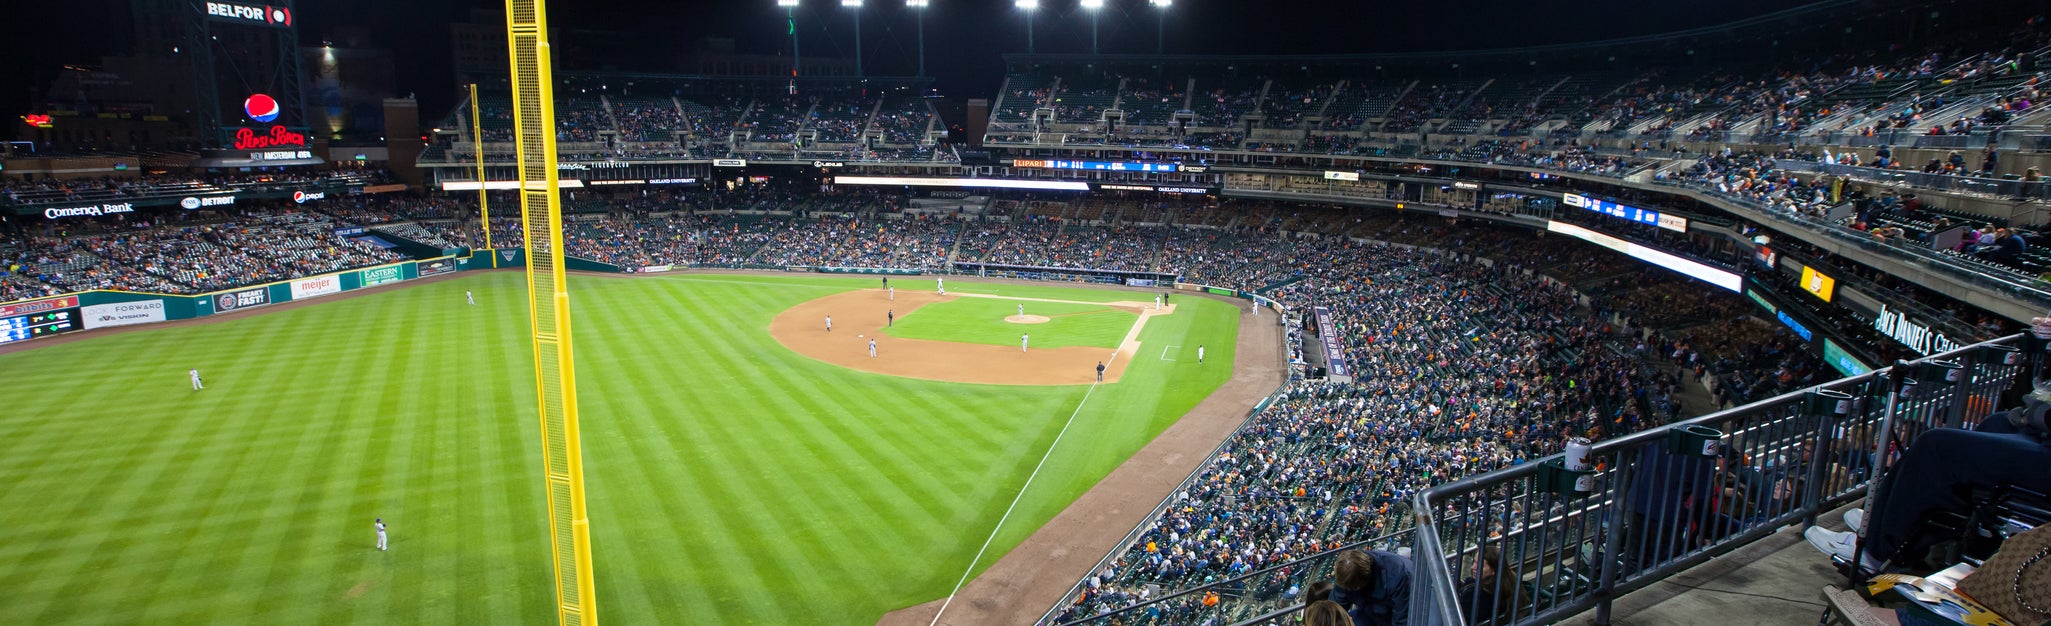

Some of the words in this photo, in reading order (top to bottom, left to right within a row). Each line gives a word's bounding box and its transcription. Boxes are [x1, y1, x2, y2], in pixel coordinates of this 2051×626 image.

[207, 2, 265, 20] BELFOR
[235, 128, 268, 150] PEPSI
[270, 125, 305, 147] PORCH
[202, 196, 235, 206] DETROIT
[305, 191, 325, 201] pepsi
[103, 202, 134, 214] Bank
[364, 267, 398, 278] EASTERN
[301, 278, 331, 290] meijer
[238, 289, 265, 298] FREAKY
[238, 294, 265, 306] FAST!
[115, 303, 162, 312] FORWARD
[1874, 303, 1898, 337] JACK
[1893, 312, 1933, 356] DANIEL'S
